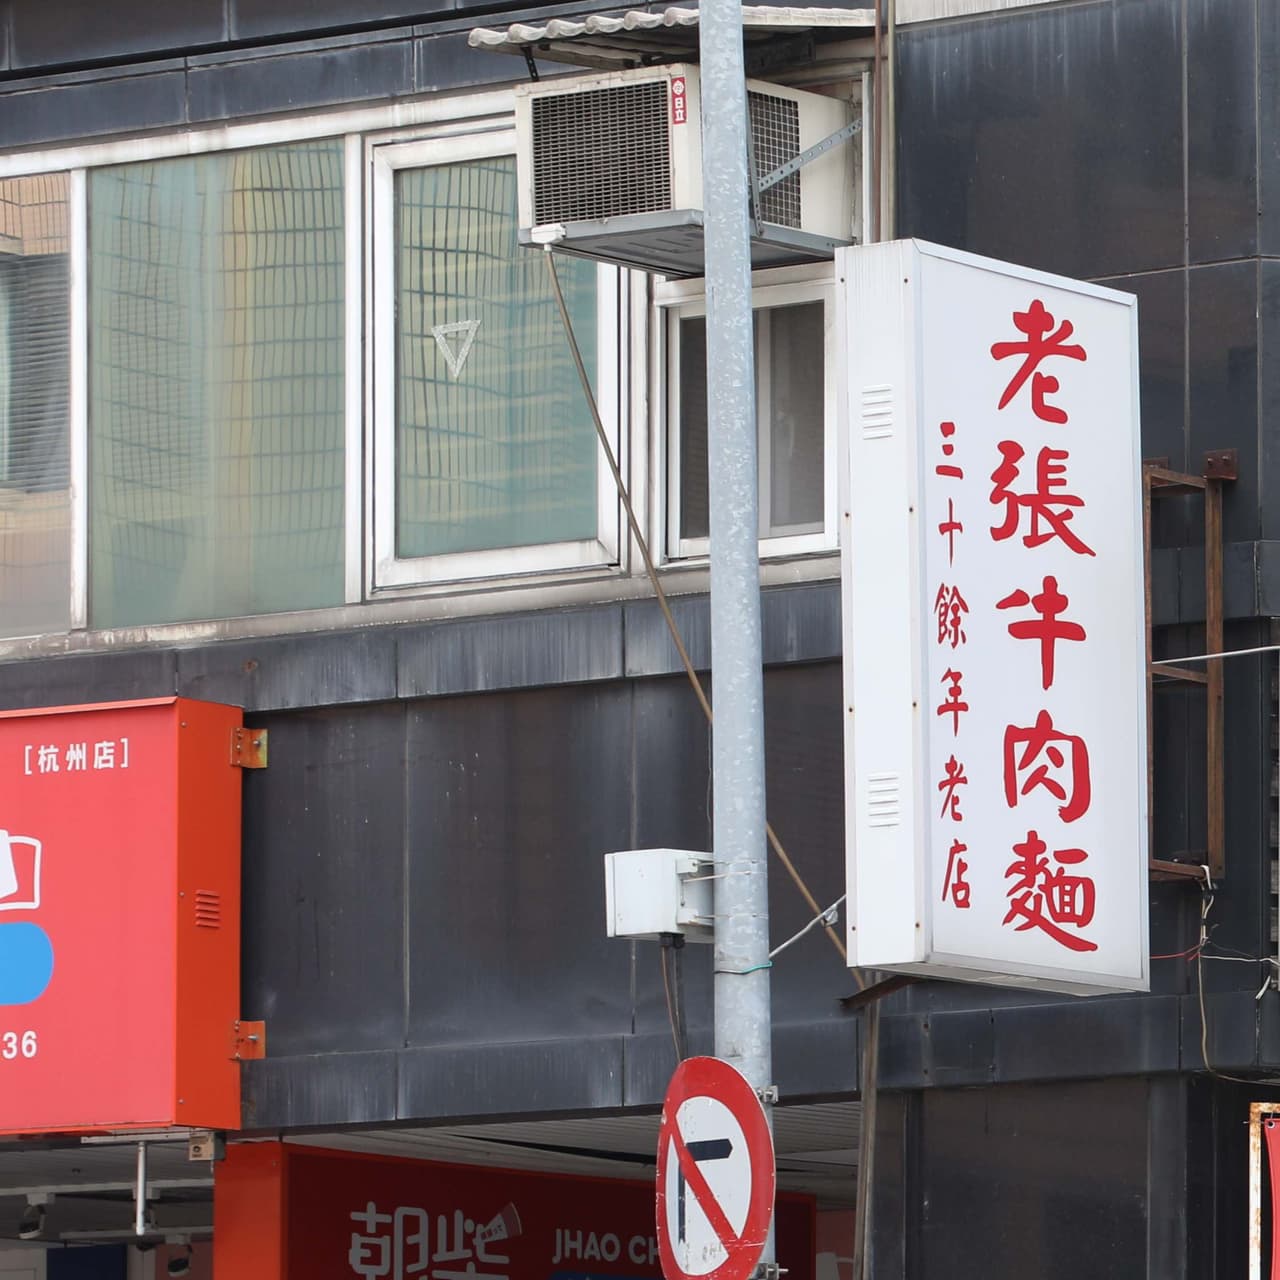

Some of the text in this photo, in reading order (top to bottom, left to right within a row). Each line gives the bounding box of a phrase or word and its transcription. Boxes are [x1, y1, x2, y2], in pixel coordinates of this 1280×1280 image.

[674, 97, 685, 121] 日立
[933, 421, 972, 910] 三十餘年老店
[990, 298, 1099, 953] 老張牛肉麵
[552, 1229, 621, 1264] JHAO
